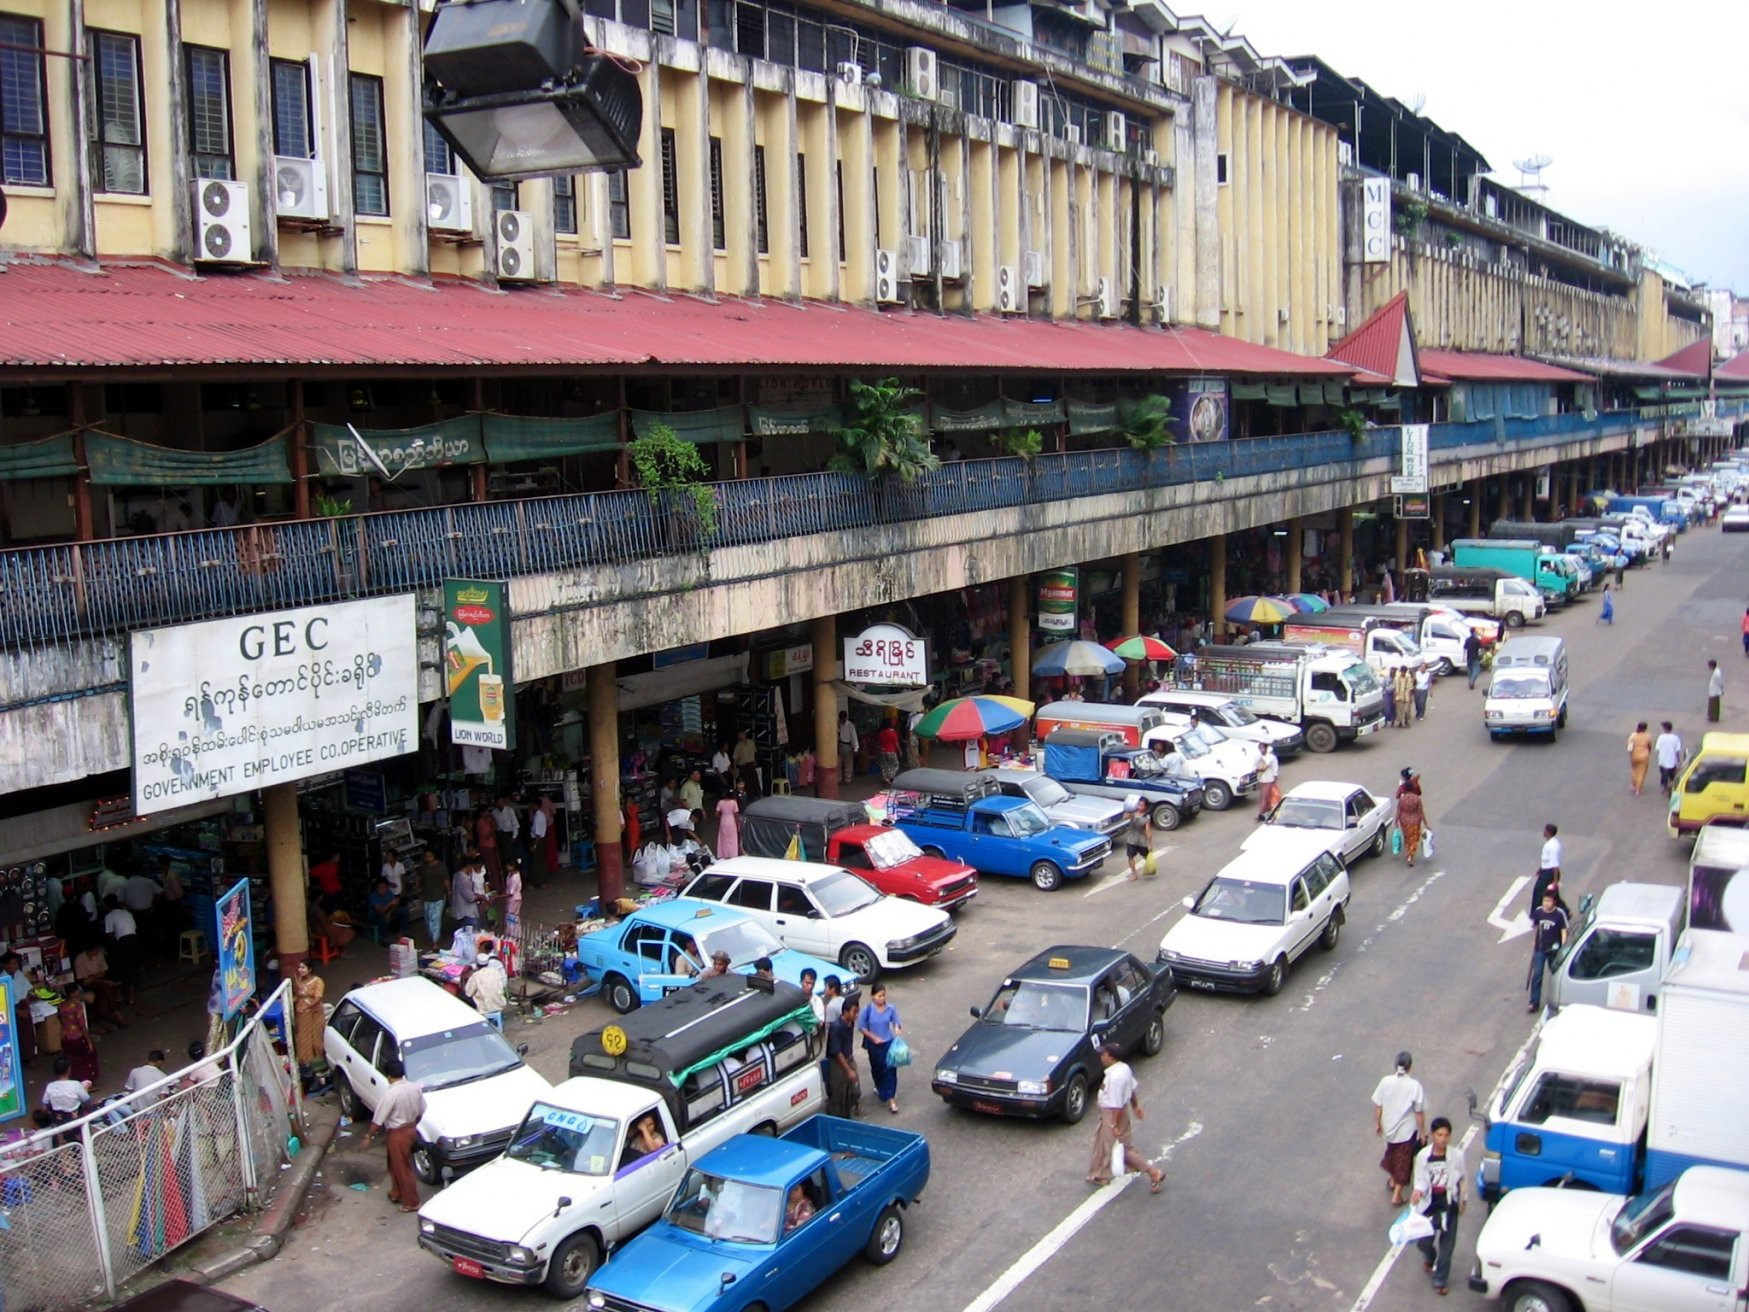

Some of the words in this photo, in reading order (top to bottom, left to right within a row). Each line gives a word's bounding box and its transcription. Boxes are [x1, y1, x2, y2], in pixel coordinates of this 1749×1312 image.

[1367, 184, 1382, 255] MCC
[1040, 588, 1074, 599] Myanmar
[240, 617, 329, 661] GEC
[849, 668, 921, 681] RESTAURANT
[455, 728, 472, 741] LION
[474, 730, 504, 745] WORLD
[143, 766, 235, 800] GOVERNMENT
[244, 749, 313, 778] EMPLOYEE
[321, 728, 407, 760] CO.OPERATIVE
[547, 1111, 577, 1125] CNG
